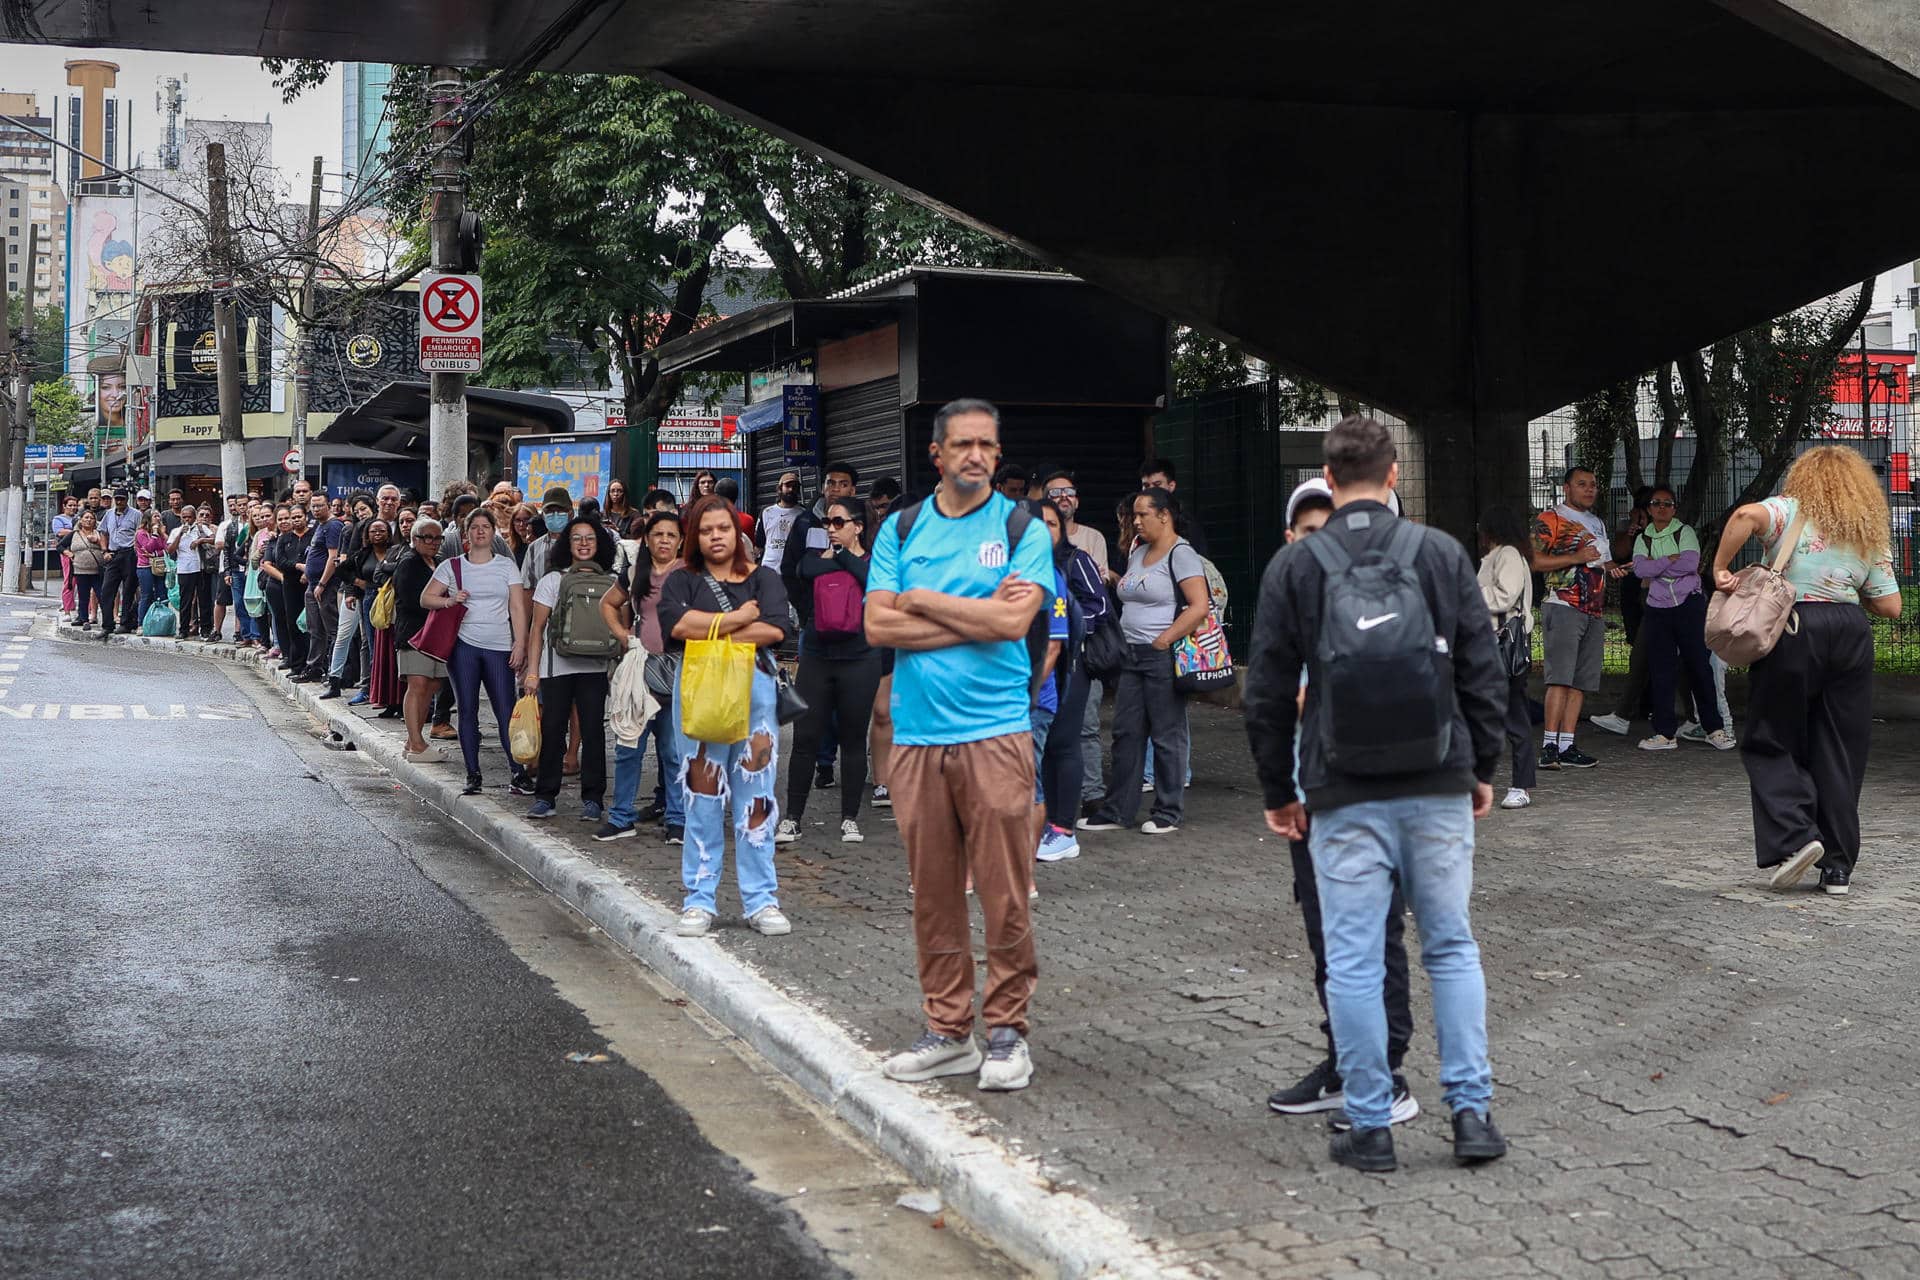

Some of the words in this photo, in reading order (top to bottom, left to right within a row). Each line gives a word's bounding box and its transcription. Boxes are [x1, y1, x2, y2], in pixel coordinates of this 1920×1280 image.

[669, 409, 687, 417] AXI
[182, 425, 213, 436] Happy
[529, 447, 600, 480] Méqui
[357, 474, 389, 485] Corona
[1196, 667, 1233, 681] SEPHORA
[0, 704, 252, 720] NIBUS
